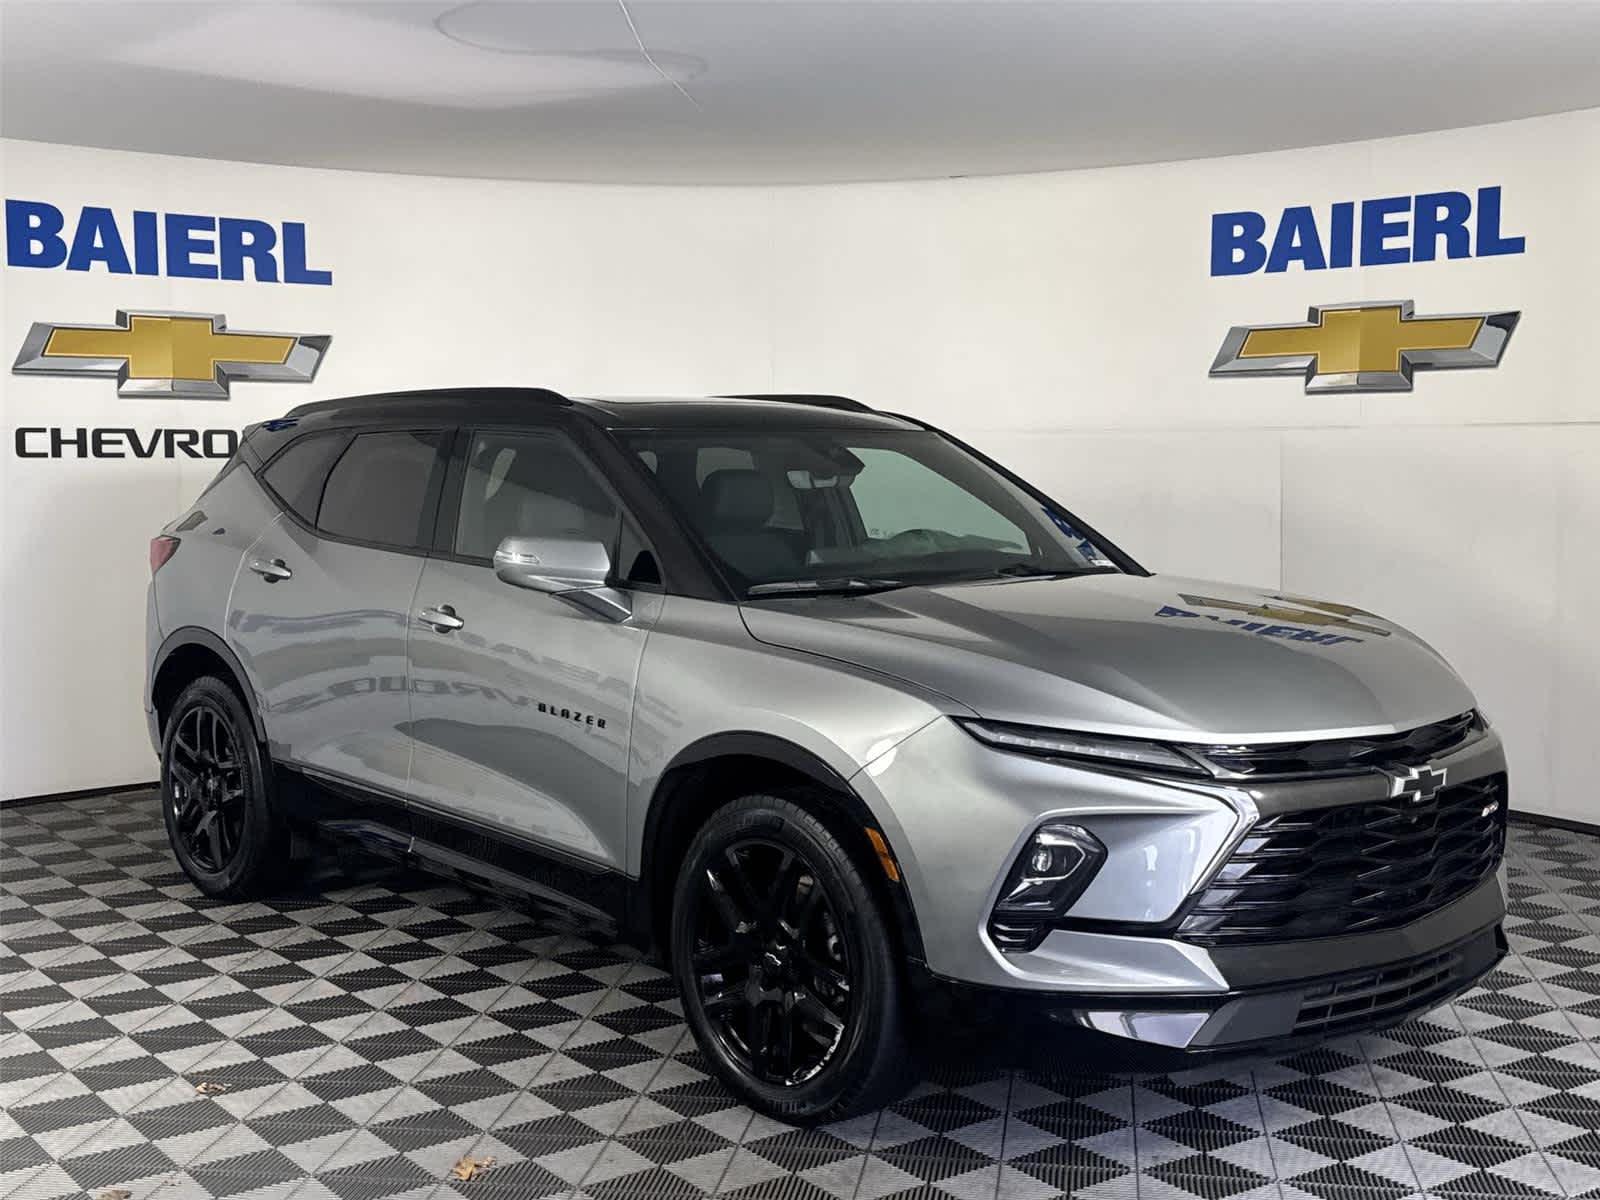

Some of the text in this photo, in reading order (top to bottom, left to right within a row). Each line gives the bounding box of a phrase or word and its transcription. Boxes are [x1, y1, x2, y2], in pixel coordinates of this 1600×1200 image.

[5, 199, 333, 286] BAIERL
[1210, 185, 1526, 277] BAIERL
[15, 427, 239, 459] CHEVRO
[538, 702, 606, 729] BLAZER
